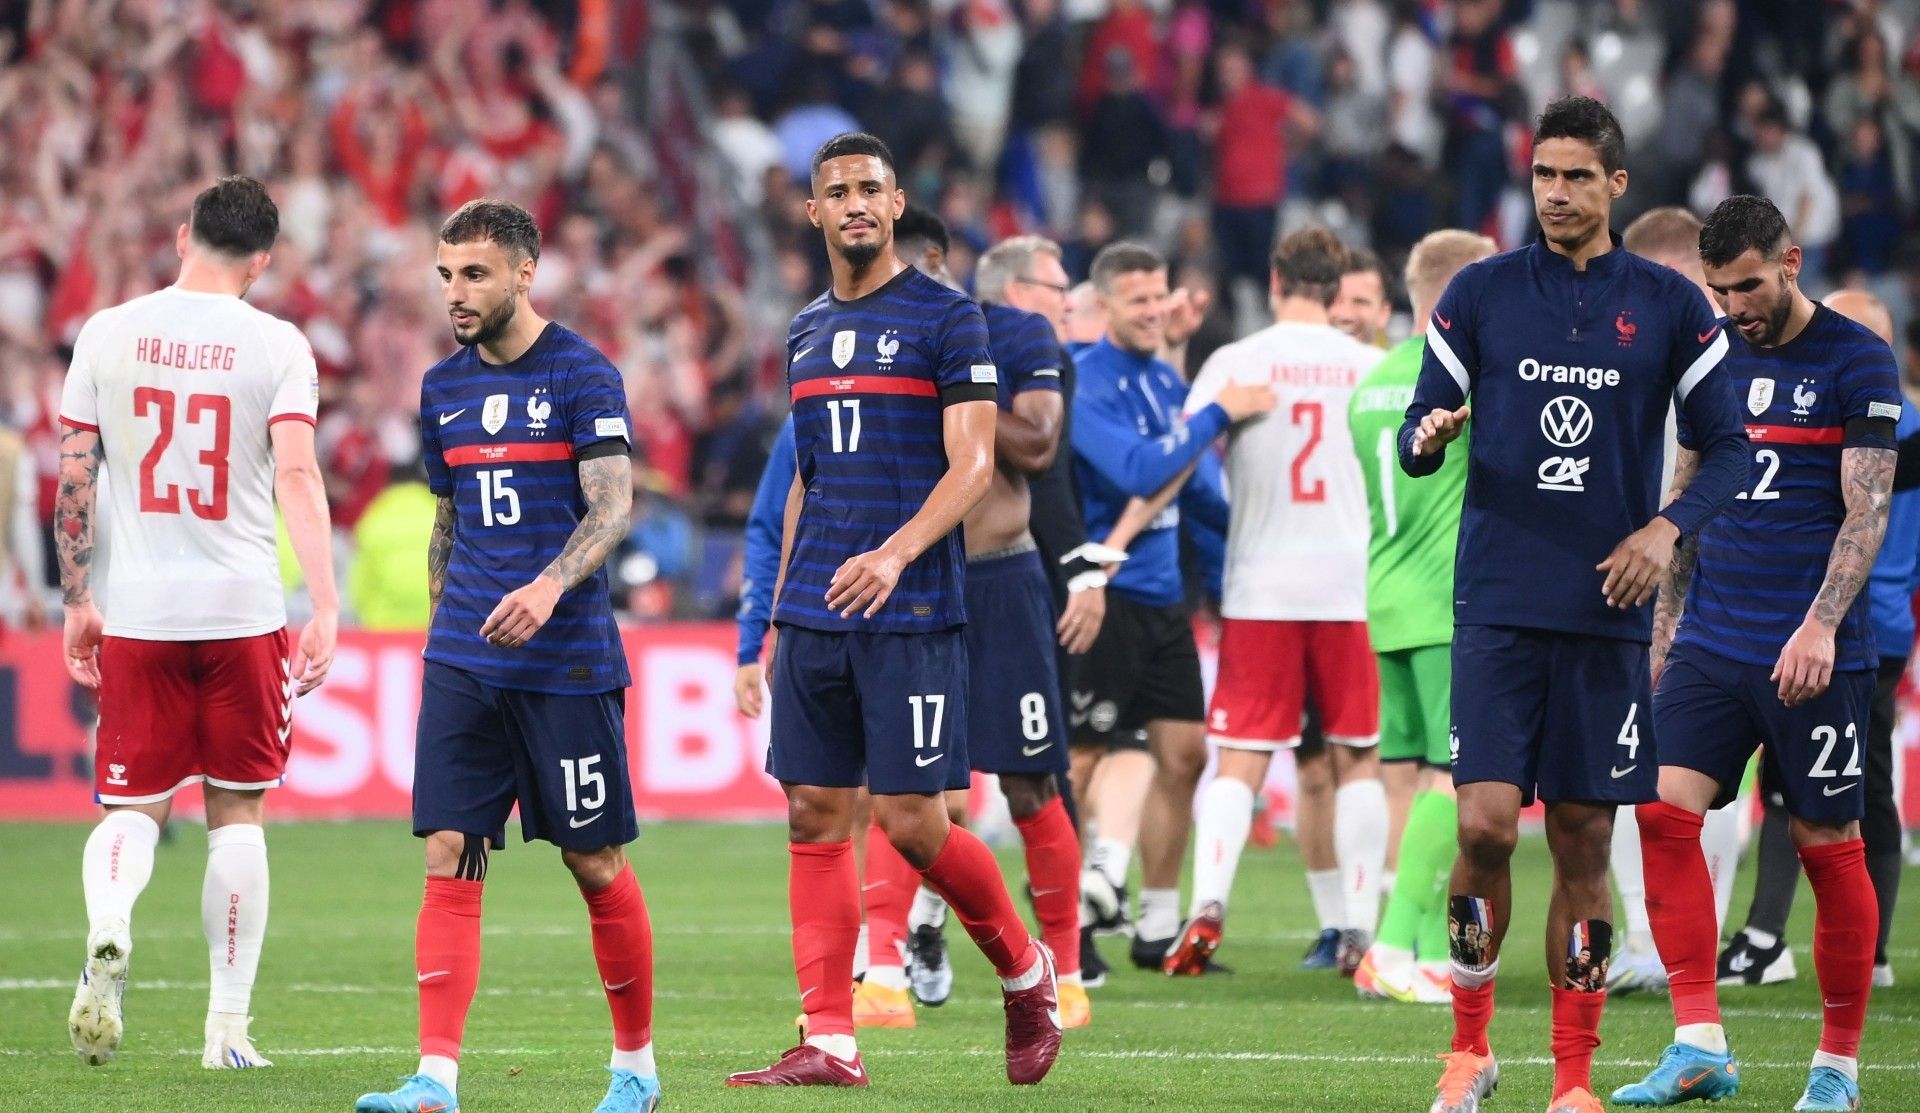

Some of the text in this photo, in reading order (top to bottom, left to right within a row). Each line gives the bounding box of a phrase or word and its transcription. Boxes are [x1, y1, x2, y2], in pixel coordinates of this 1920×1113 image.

[136, 337, 236, 371] HØJBJERG
[1518, 358, 1621, 390] Orange
[133, 386, 231, 521] 23
[826, 398, 861, 453] 17
[1290, 402, 1325, 504] 2
[476, 469, 521, 527] 15
[1376, 426, 1398, 538] 1
[1734, 449, 1780, 500] 2
[908, 694, 945, 748] 17
[1019, 692, 1049, 741] 8
[1617, 702, 1640, 760] 4
[1807, 722, 1862, 778] 22
[560, 753, 606, 811] 15
[110, 832, 125, 882] DANMARK
[228, 893, 240, 967] DANMARK
